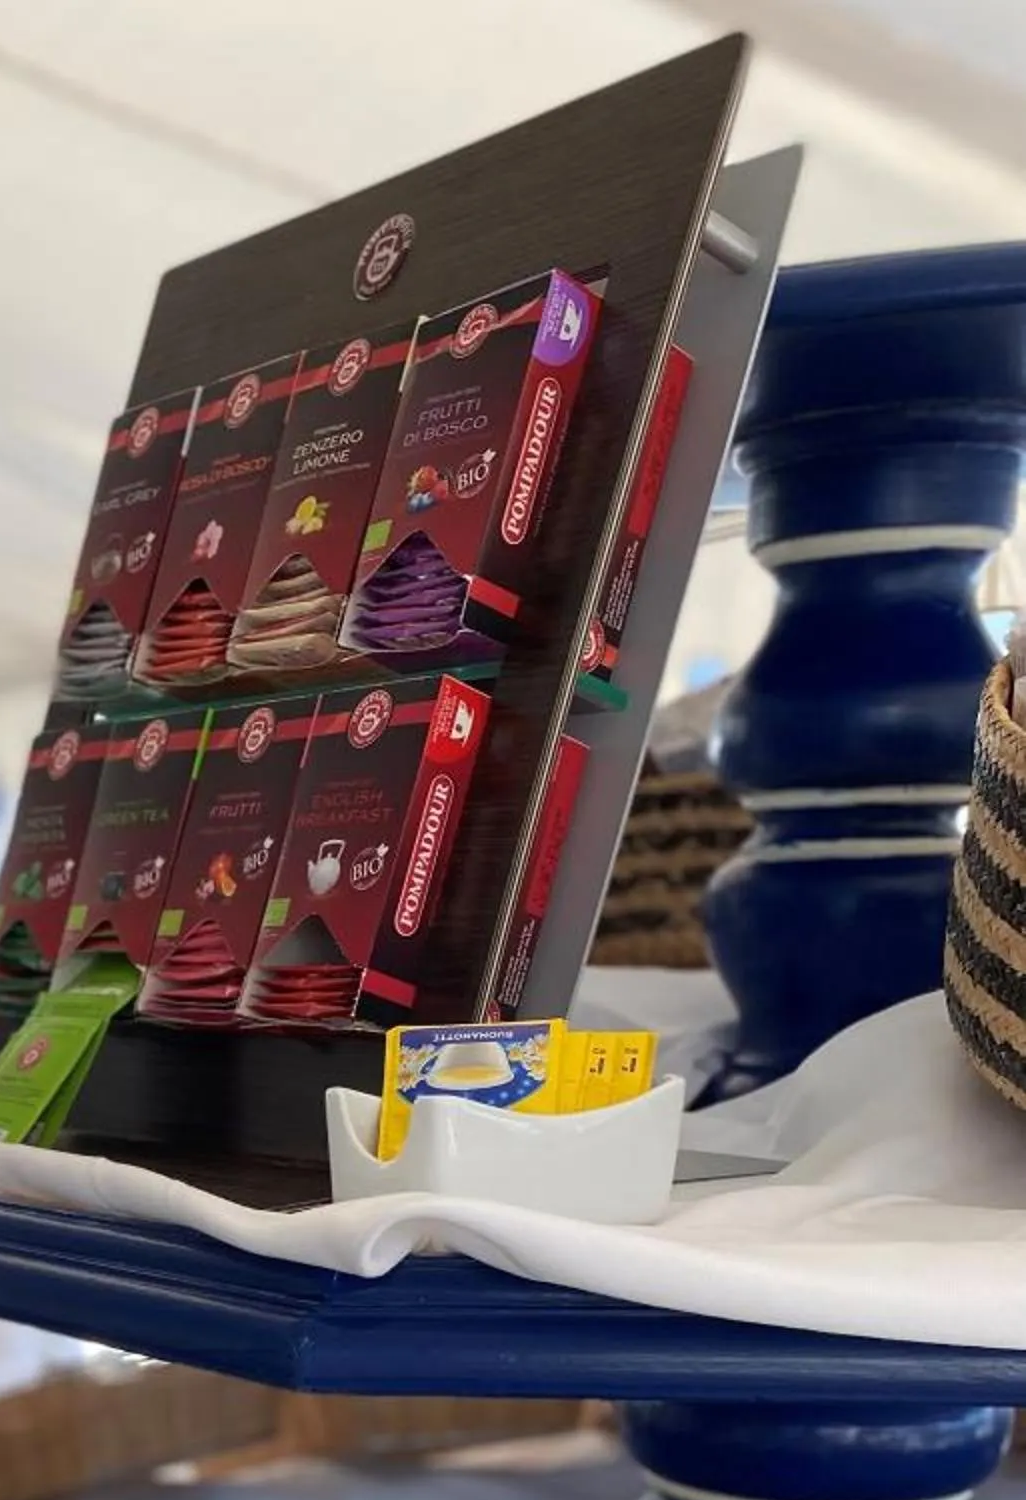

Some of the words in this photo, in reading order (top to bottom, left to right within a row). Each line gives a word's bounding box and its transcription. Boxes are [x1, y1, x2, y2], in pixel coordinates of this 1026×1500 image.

[417, 398, 481, 425] FRUTTI
[292, 429, 364, 460] ZENZERO
[403, 432, 420, 447] DI
[423, 415, 488, 441] BOSCO
[293, 448, 351, 475] LIMONE
[506, 385, 557, 536] POMPADOUR
[457, 463, 490, 491] BIO
[209, 802, 262, 818] FRUTTI
[243, 849, 269, 873] BIO
[353, 857, 383, 881] BIO
[399, 783, 450, 928] POMPADOUR
